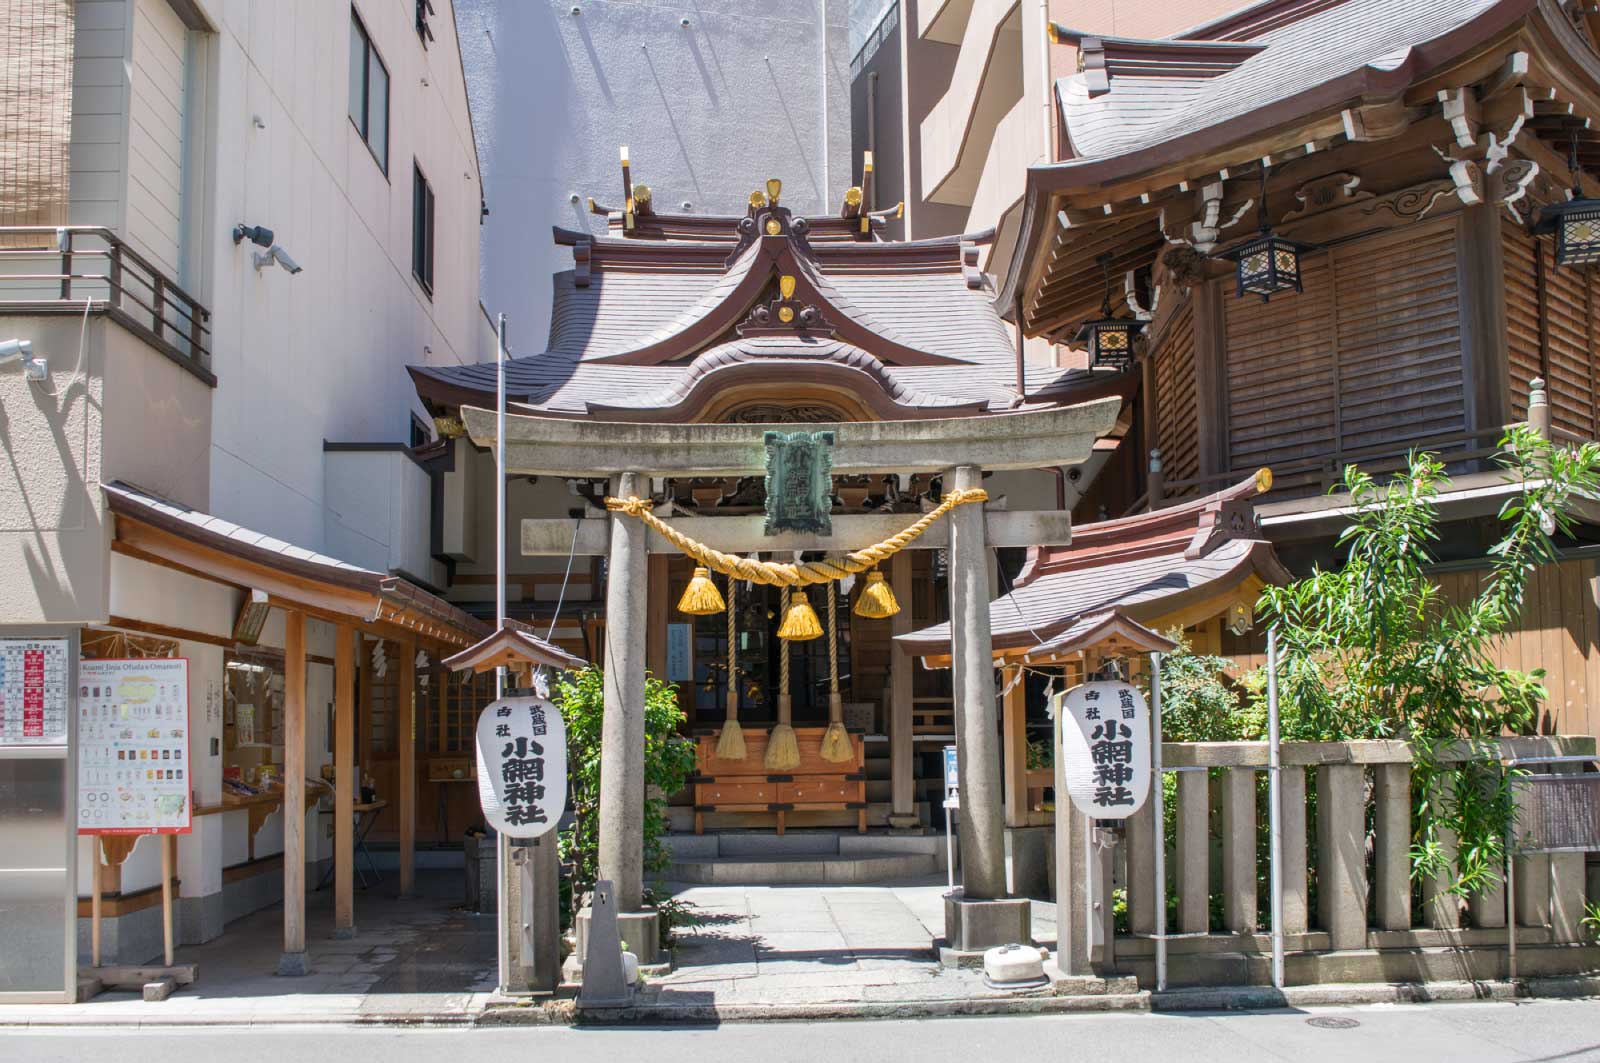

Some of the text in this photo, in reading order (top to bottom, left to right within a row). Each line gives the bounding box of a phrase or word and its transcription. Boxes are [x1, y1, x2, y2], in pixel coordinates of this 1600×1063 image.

[501, 736, 548, 826] 小網神社
[1091, 720, 1135, 807] 小網神社
